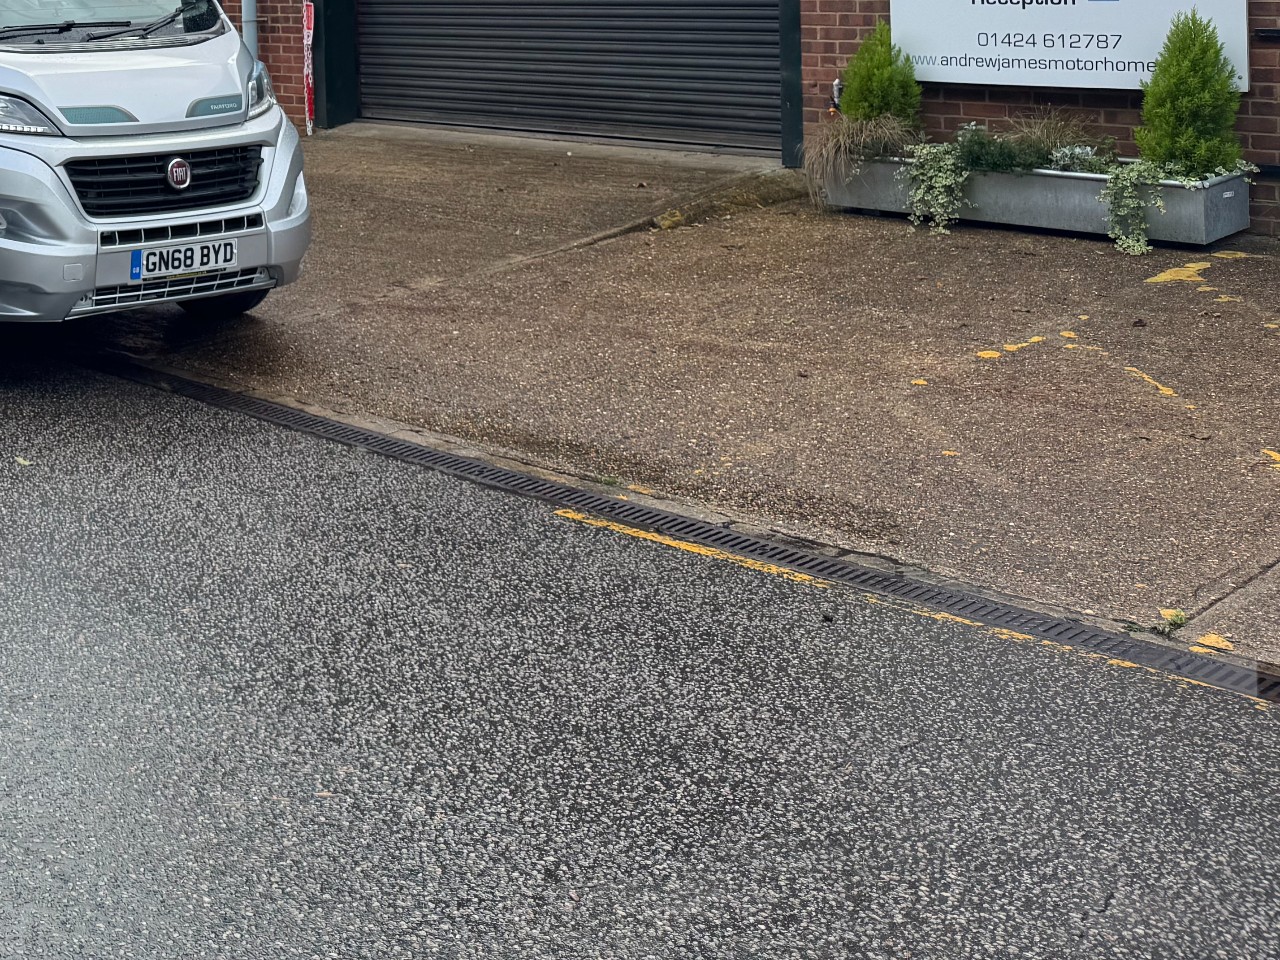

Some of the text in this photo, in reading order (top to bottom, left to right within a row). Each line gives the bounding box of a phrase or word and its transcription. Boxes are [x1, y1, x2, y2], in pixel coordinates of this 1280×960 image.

[977, 32, 1123, 50] 01424 612787
[173, 167, 186, 182] FIAT
[145, 242, 234, 273] GN68 BYD
